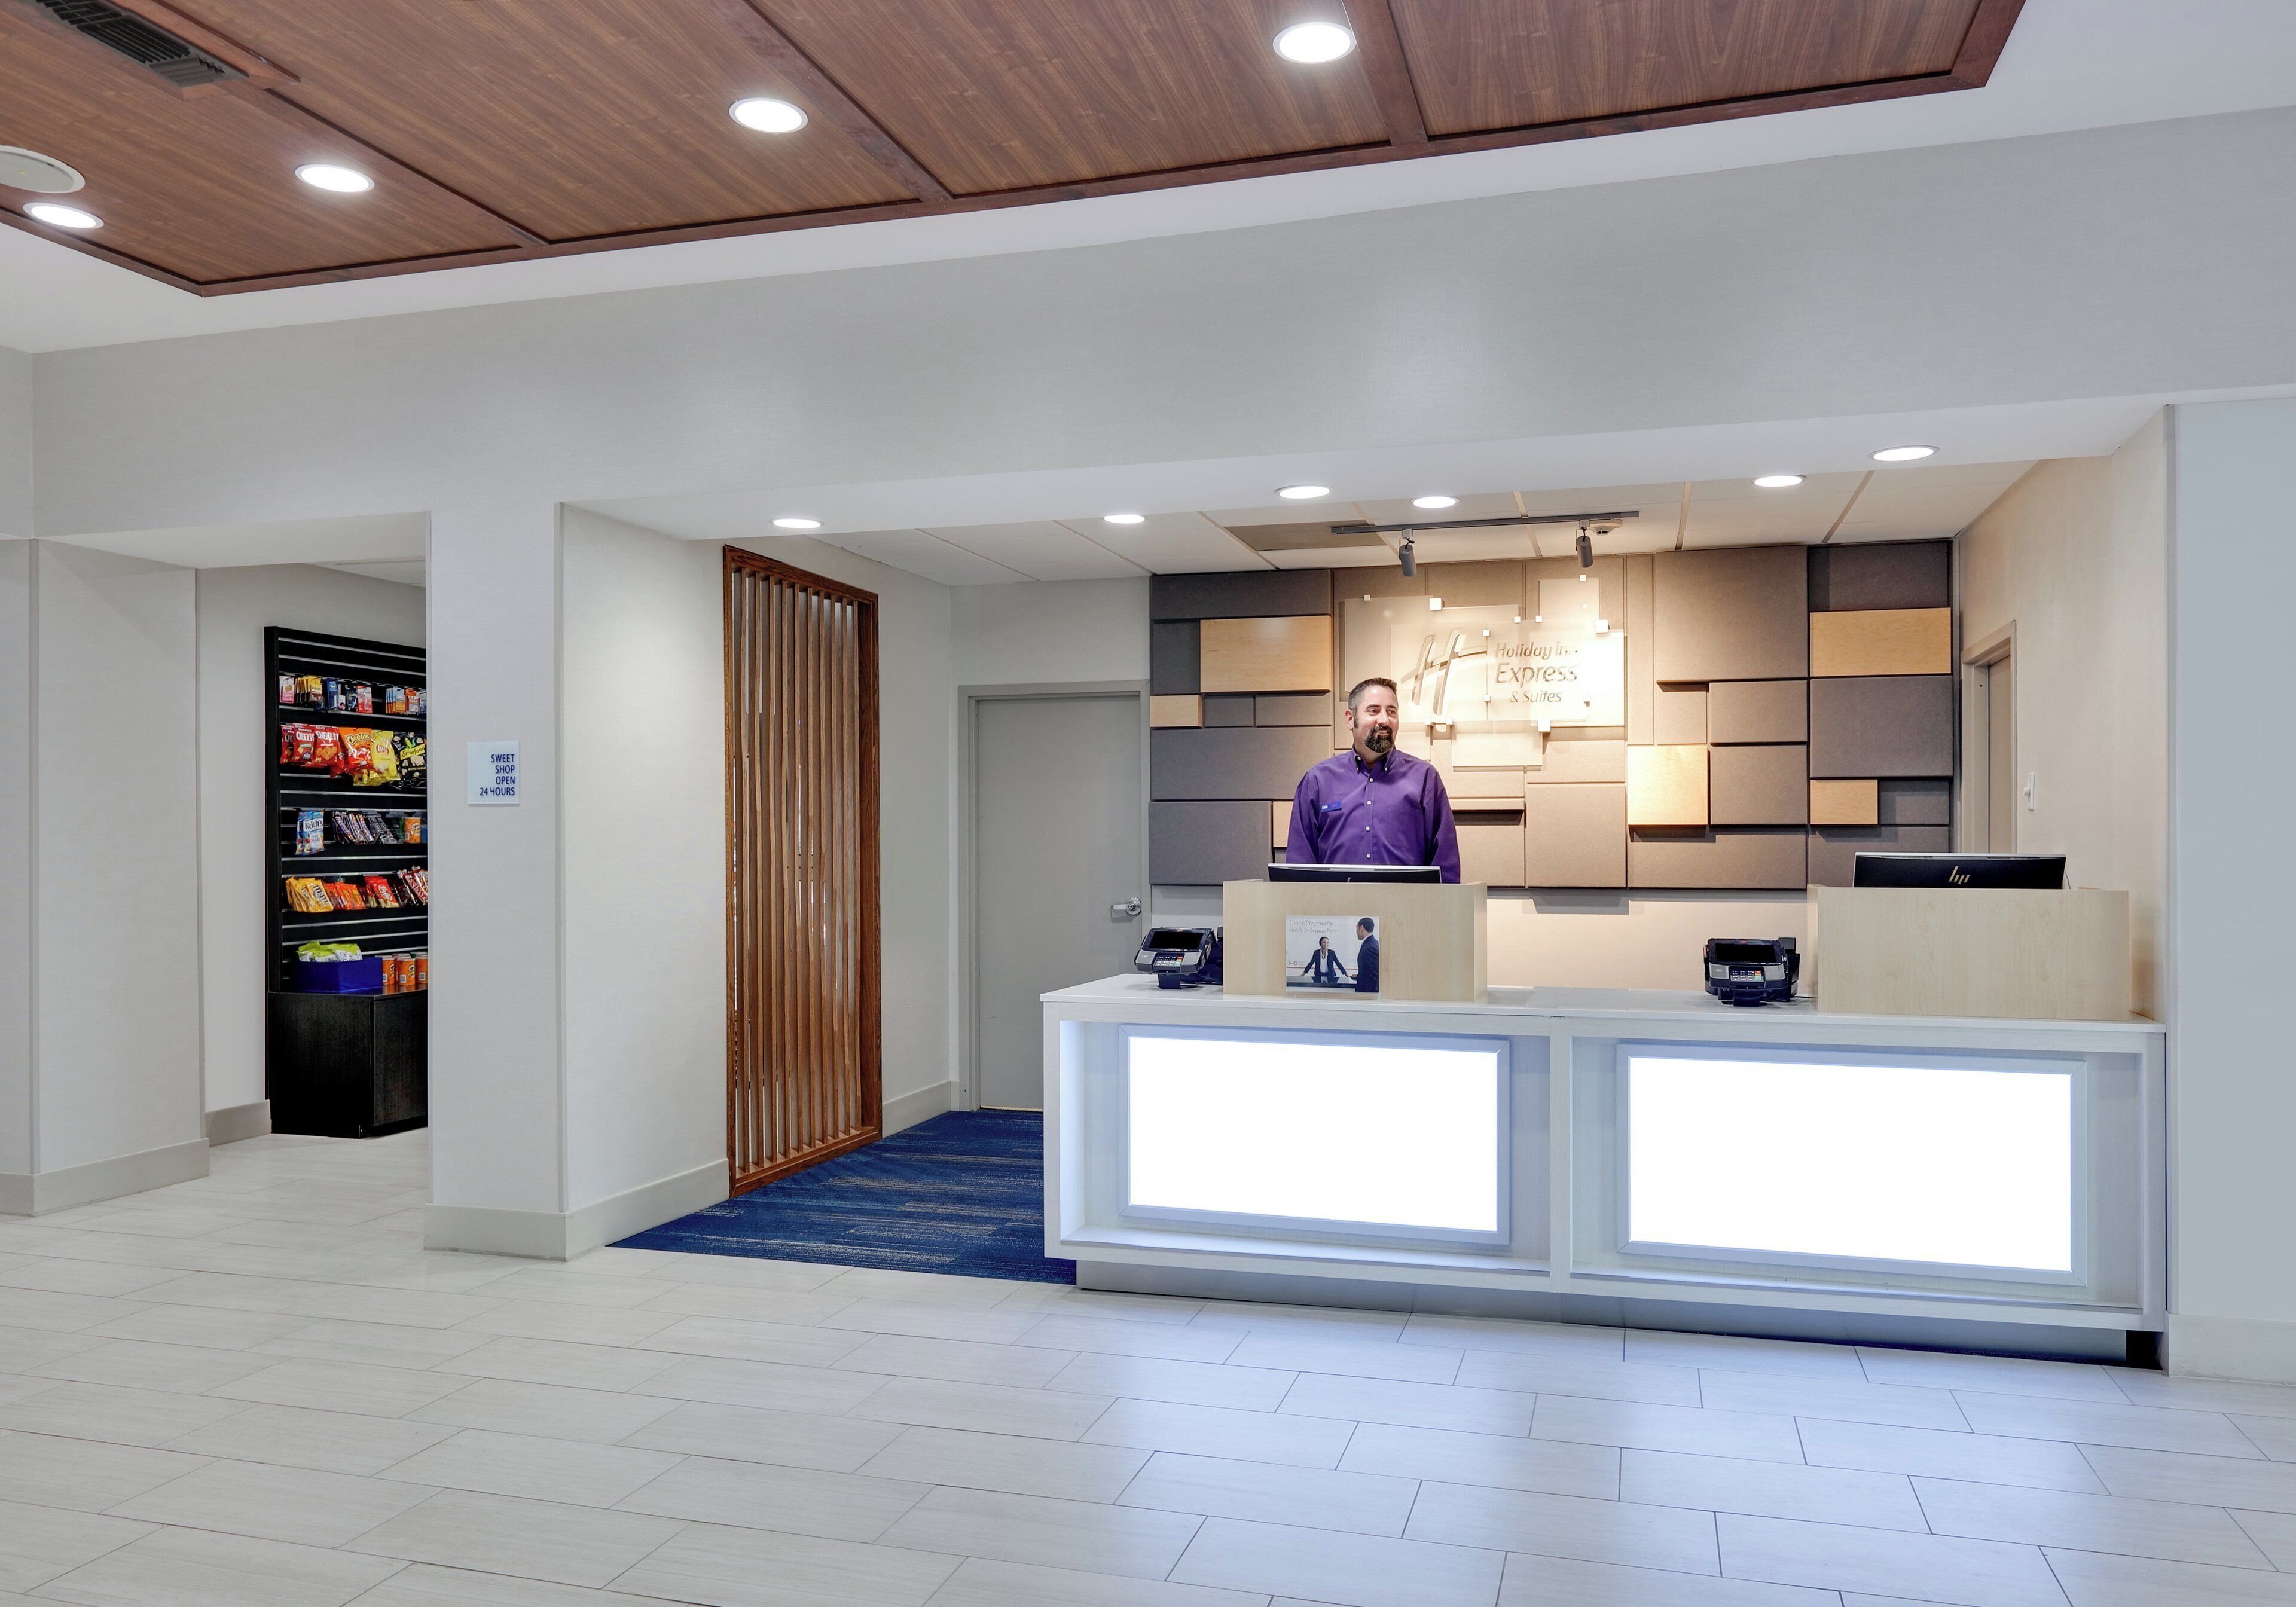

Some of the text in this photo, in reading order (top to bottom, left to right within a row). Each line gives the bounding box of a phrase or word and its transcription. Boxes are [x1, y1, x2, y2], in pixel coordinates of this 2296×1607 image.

[1495, 641, 1553, 660] Holiday
[1496, 662, 1578, 688] Express
[1510, 690, 1562, 703] & Suites
[346, 732, 371, 744] Cheetos
[491, 754, 515, 763] SWEET
[495, 765, 515, 774] SHOP
[495, 776, 515, 785] OPEN
[480, 787, 515, 796] 24 HOURS
[305, 818, 323, 830] Welch's
